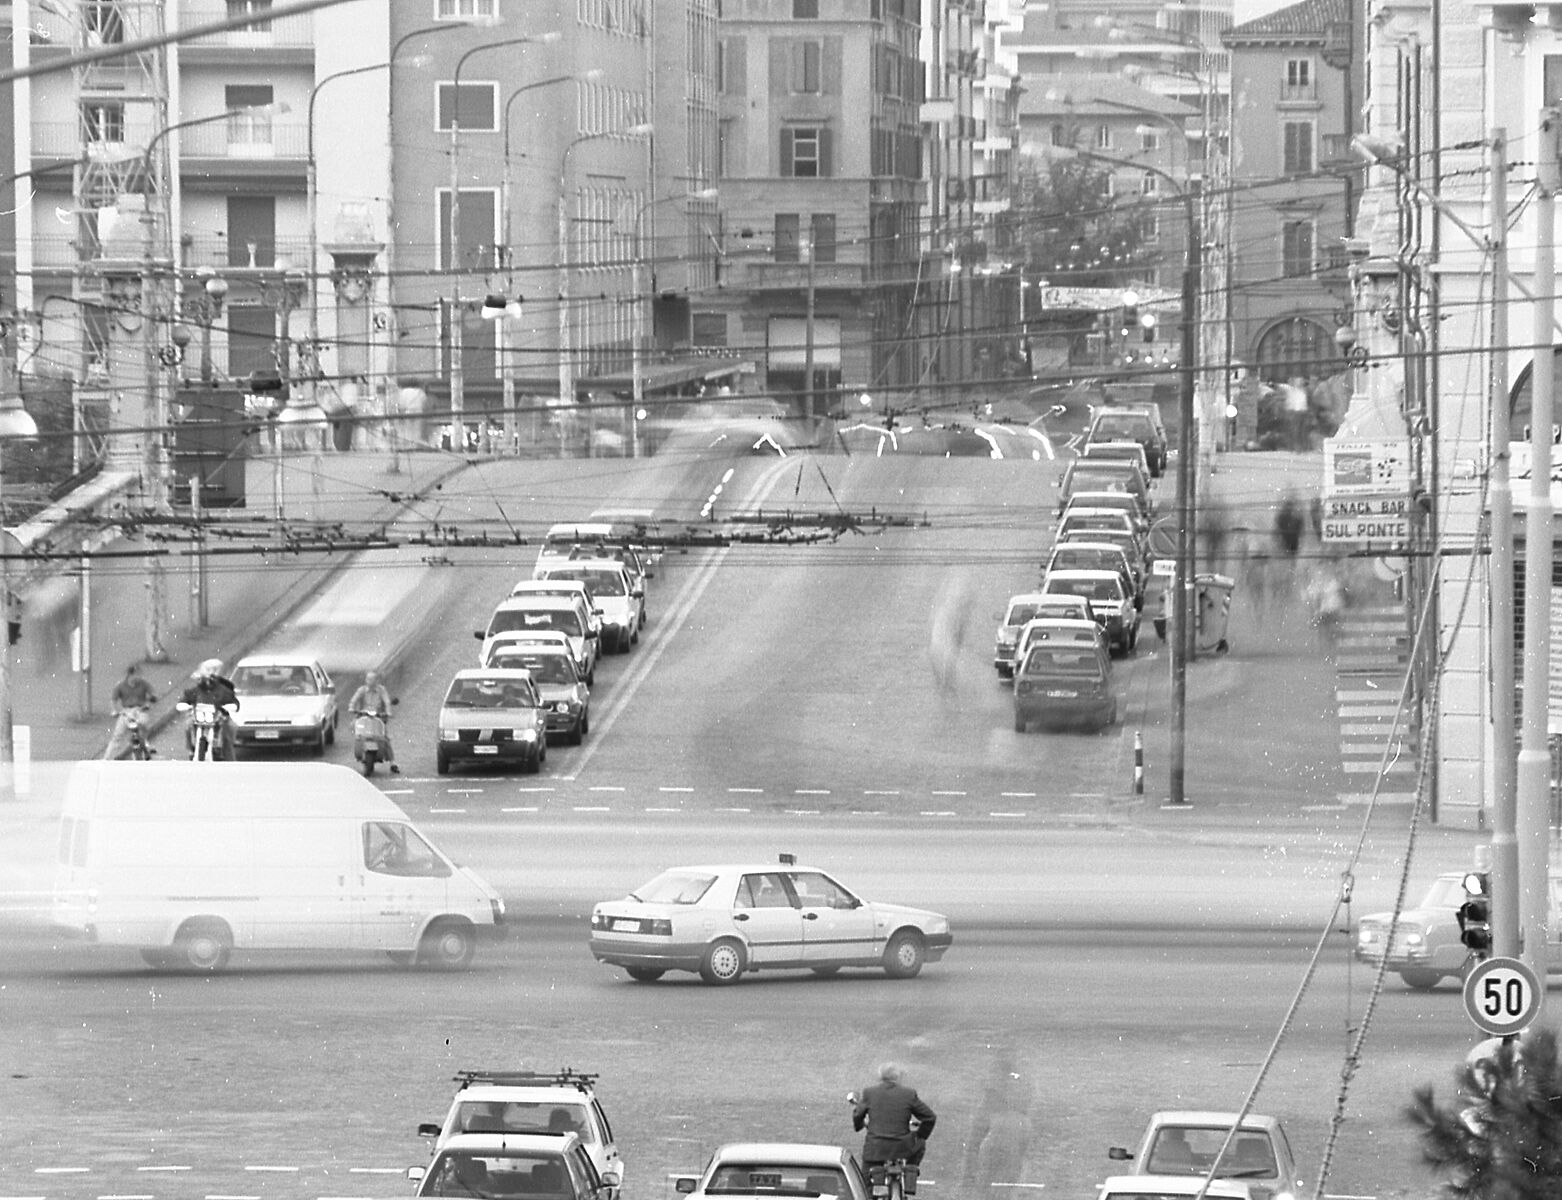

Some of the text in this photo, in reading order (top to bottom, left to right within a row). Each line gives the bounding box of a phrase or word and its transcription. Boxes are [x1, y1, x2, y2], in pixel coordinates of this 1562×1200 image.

[1381, 501, 1405, 514] BAR
[1326, 523, 1405, 538] SUL PONTE
[1484, 978, 1523, 1017] 50
